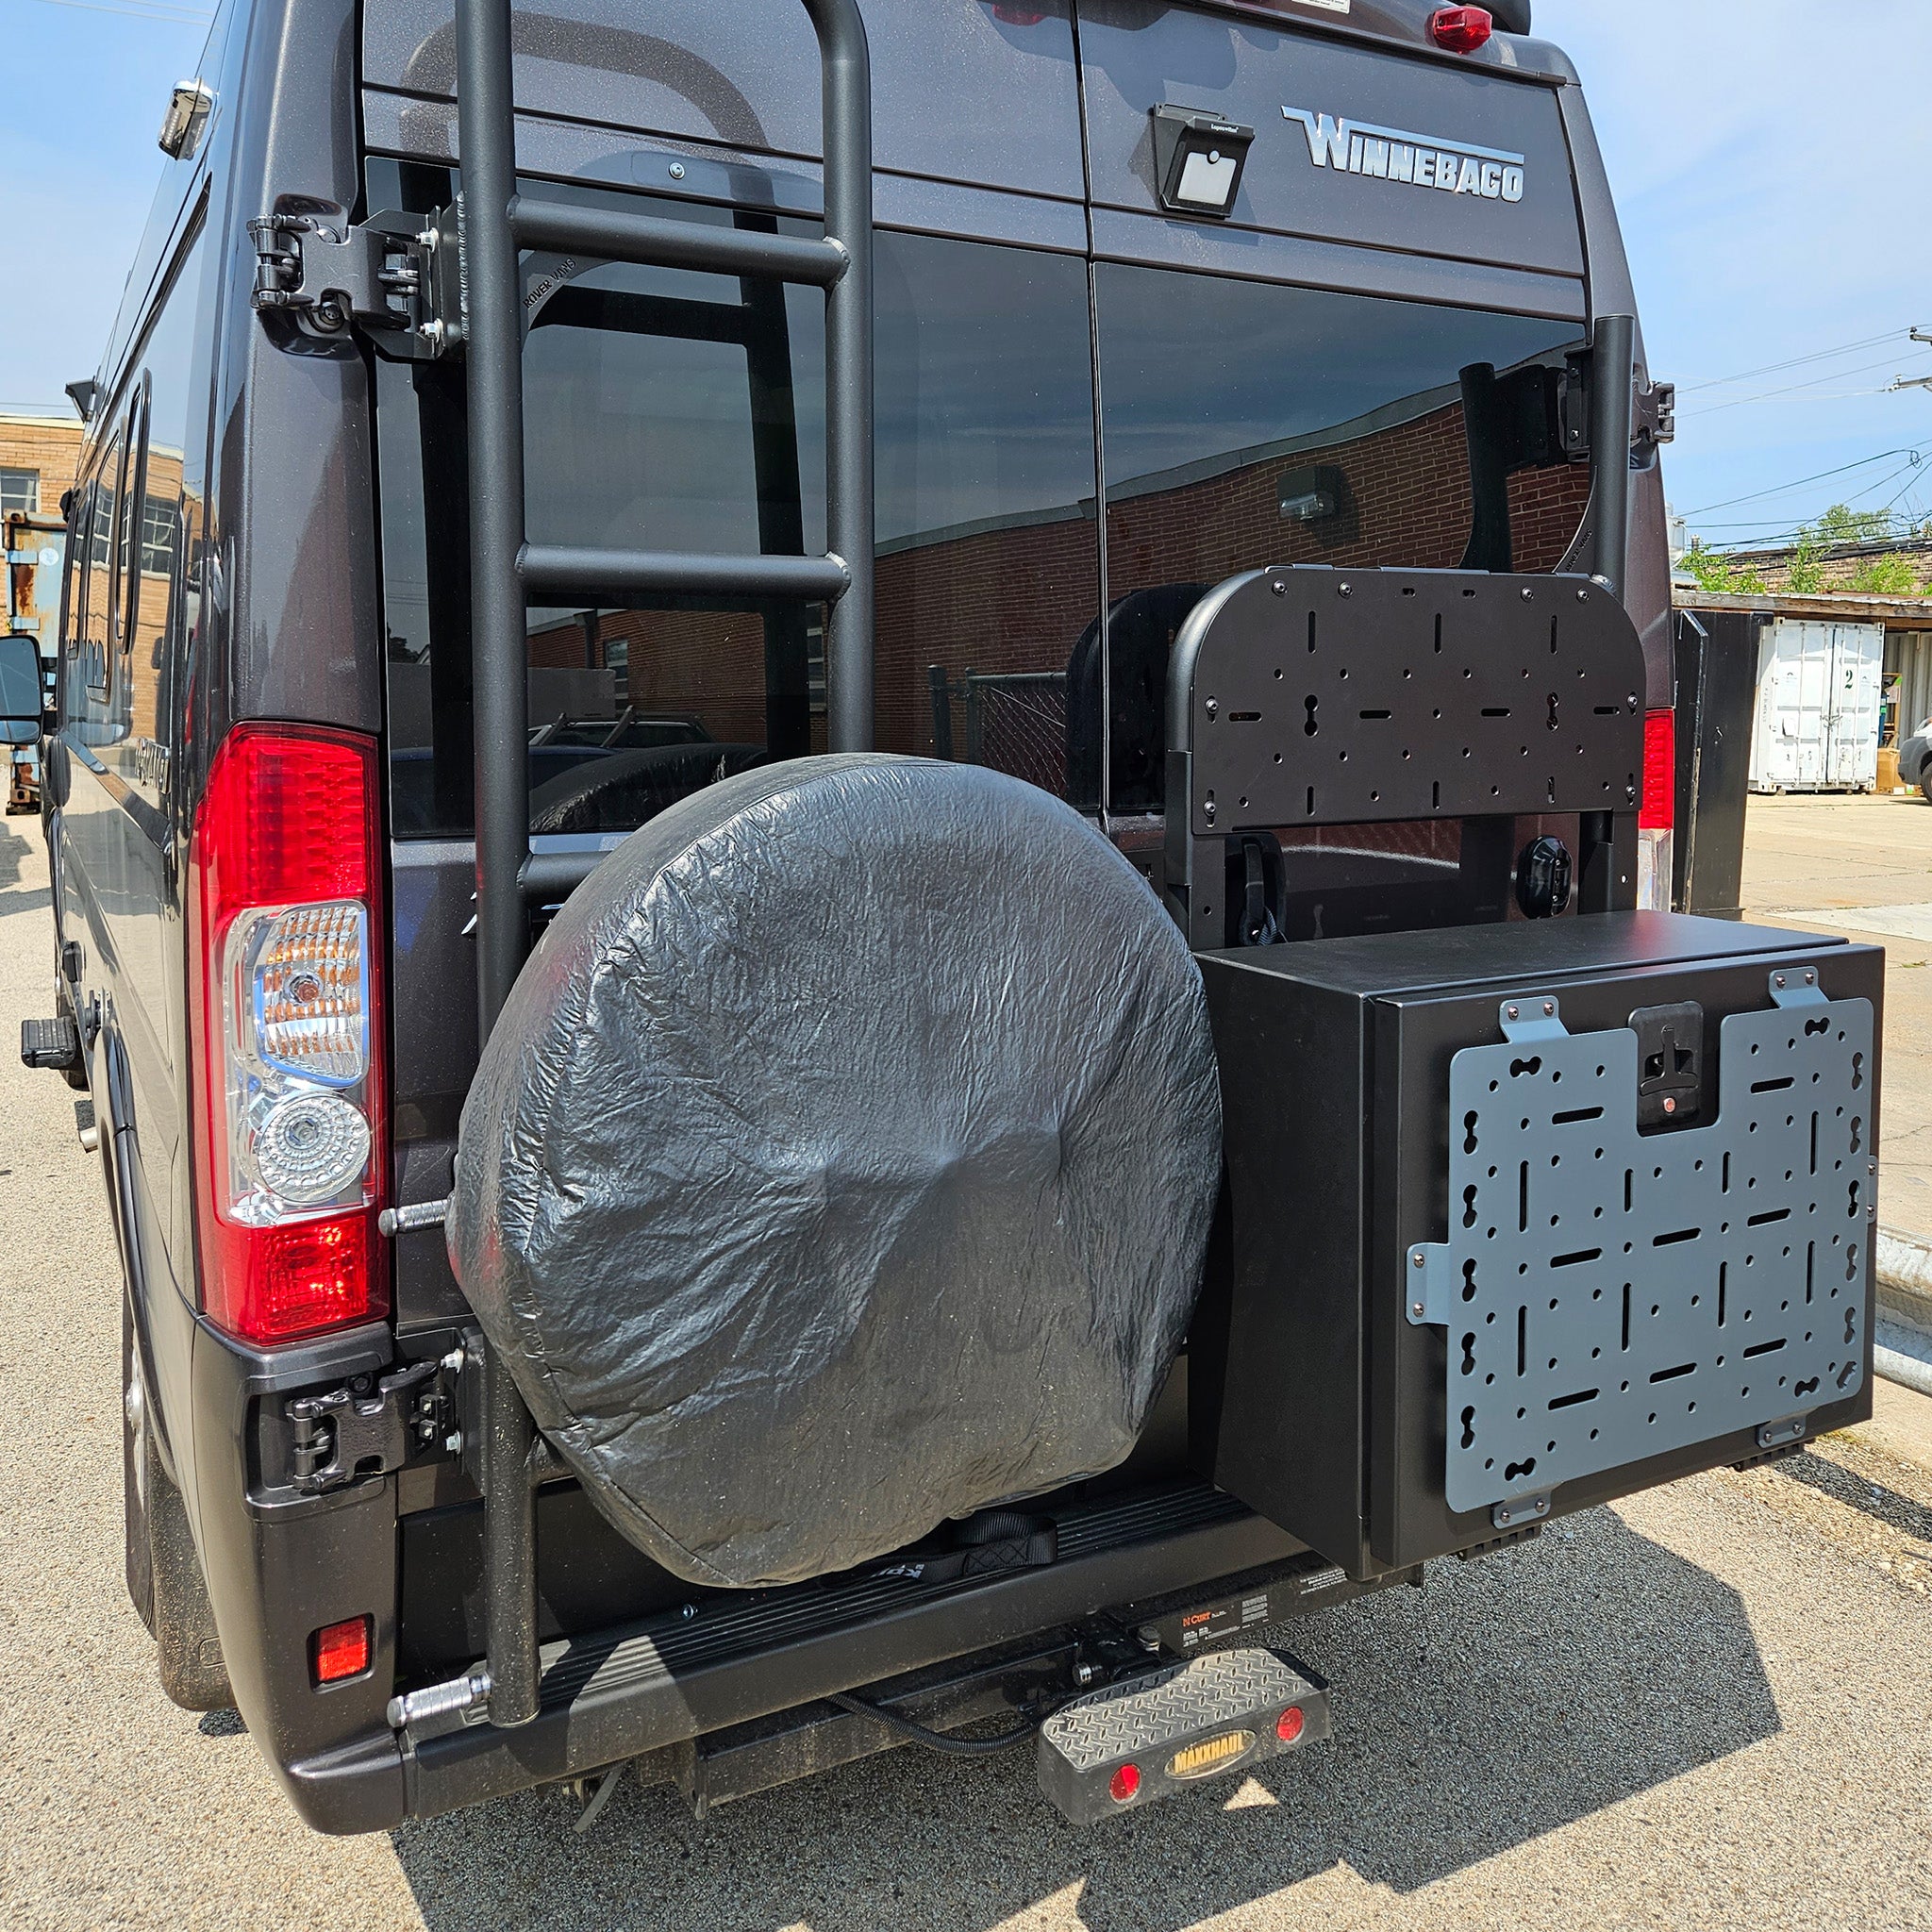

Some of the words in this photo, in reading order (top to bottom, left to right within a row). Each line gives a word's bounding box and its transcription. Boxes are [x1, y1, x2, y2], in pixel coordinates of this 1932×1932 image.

[1281, 105, 1525, 203] WINNEBAGO
[523, 279, 553, 309] ROVER
[550, 257, 576, 282] VANS
[1844, 669, 1854, 690] 2
[1174, 1733, 1244, 1774] MAXXHAUL
